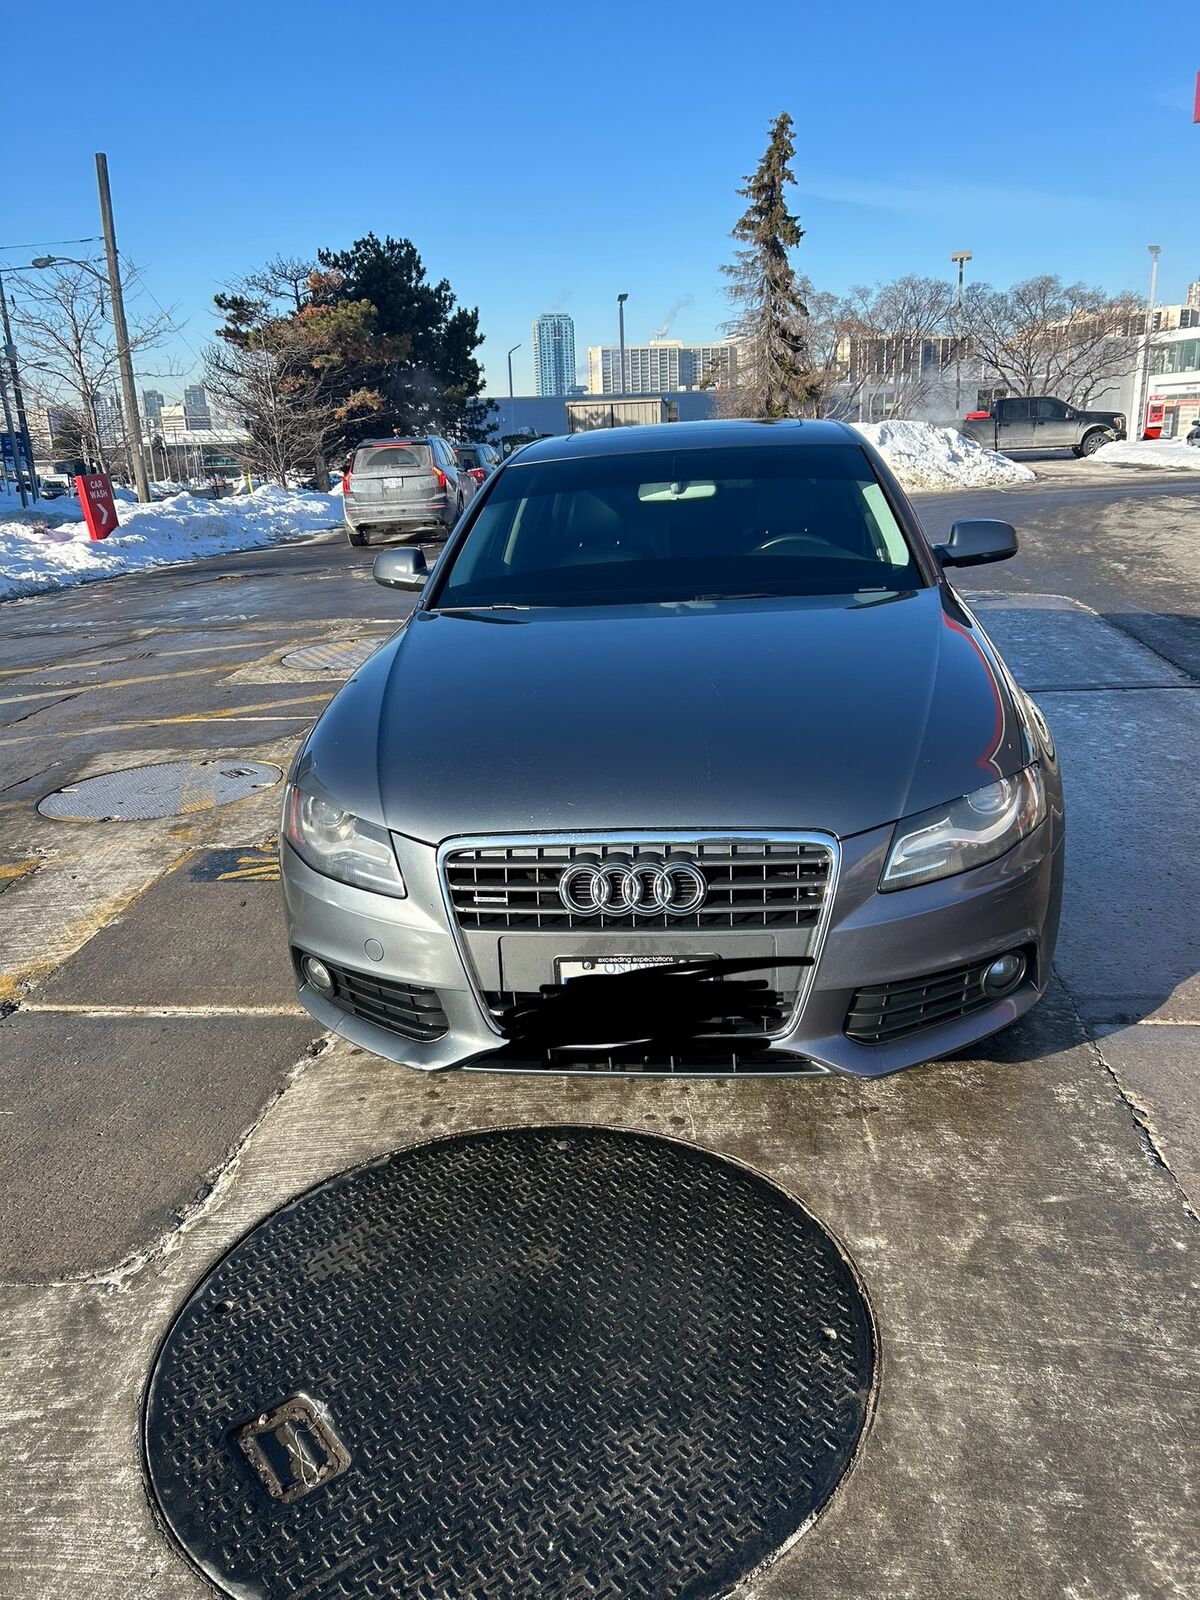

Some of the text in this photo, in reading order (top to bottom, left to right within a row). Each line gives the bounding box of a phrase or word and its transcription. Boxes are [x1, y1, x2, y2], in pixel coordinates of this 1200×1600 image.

[90, 480, 103, 489] CAR
[89, 490, 108, 499] WASH
[633, 956, 673, 964] expectations
